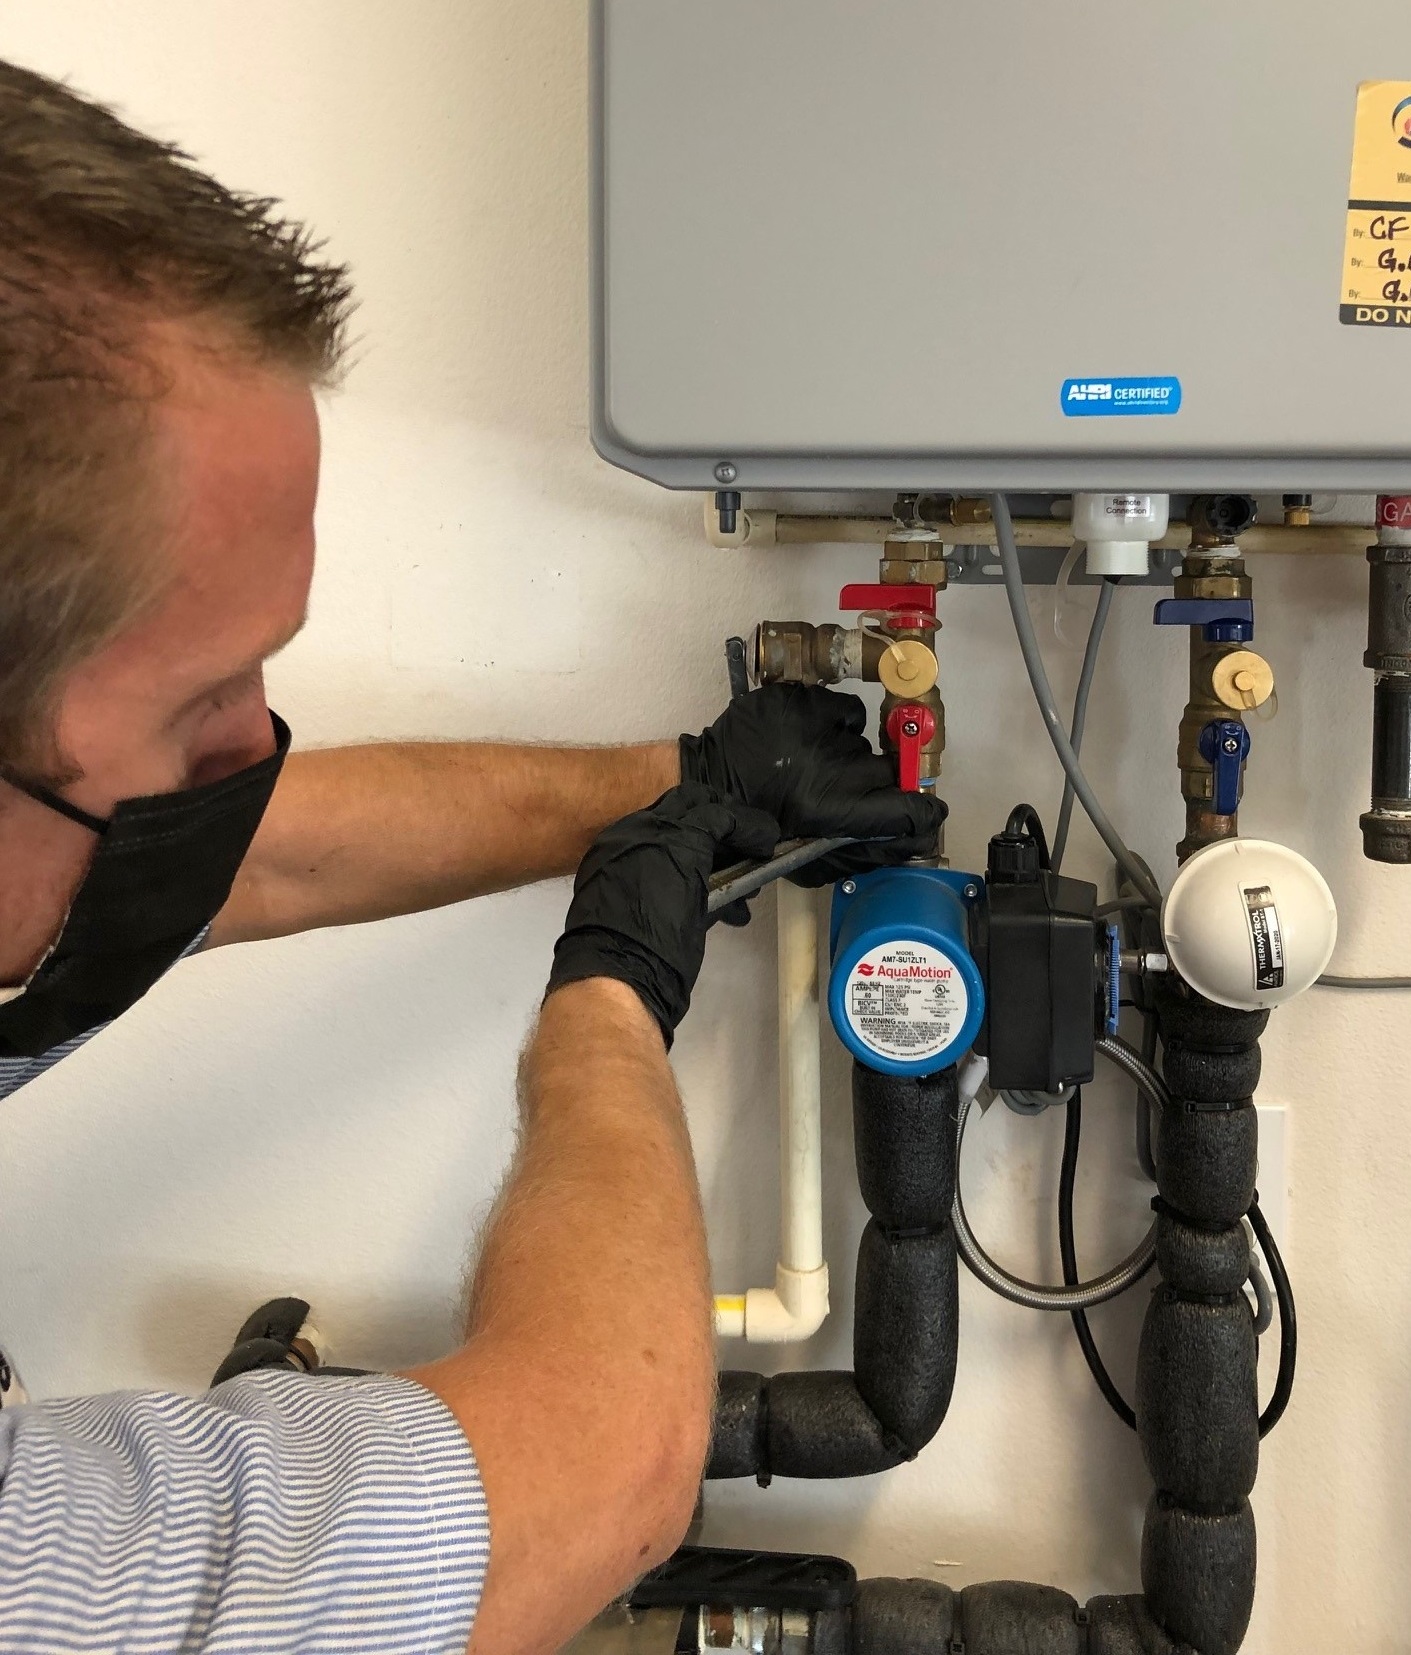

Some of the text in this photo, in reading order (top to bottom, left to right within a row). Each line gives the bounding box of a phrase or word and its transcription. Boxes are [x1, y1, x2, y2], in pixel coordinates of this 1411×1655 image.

[1356, 307, 1389, 323] DO
[1114, 387, 1170, 400] CERTIFIED
[1112, 498, 1141, 506] Remote
[1105, 506, 1147, 515] Connection
[860, 1017, 896, 1025] WARNING
